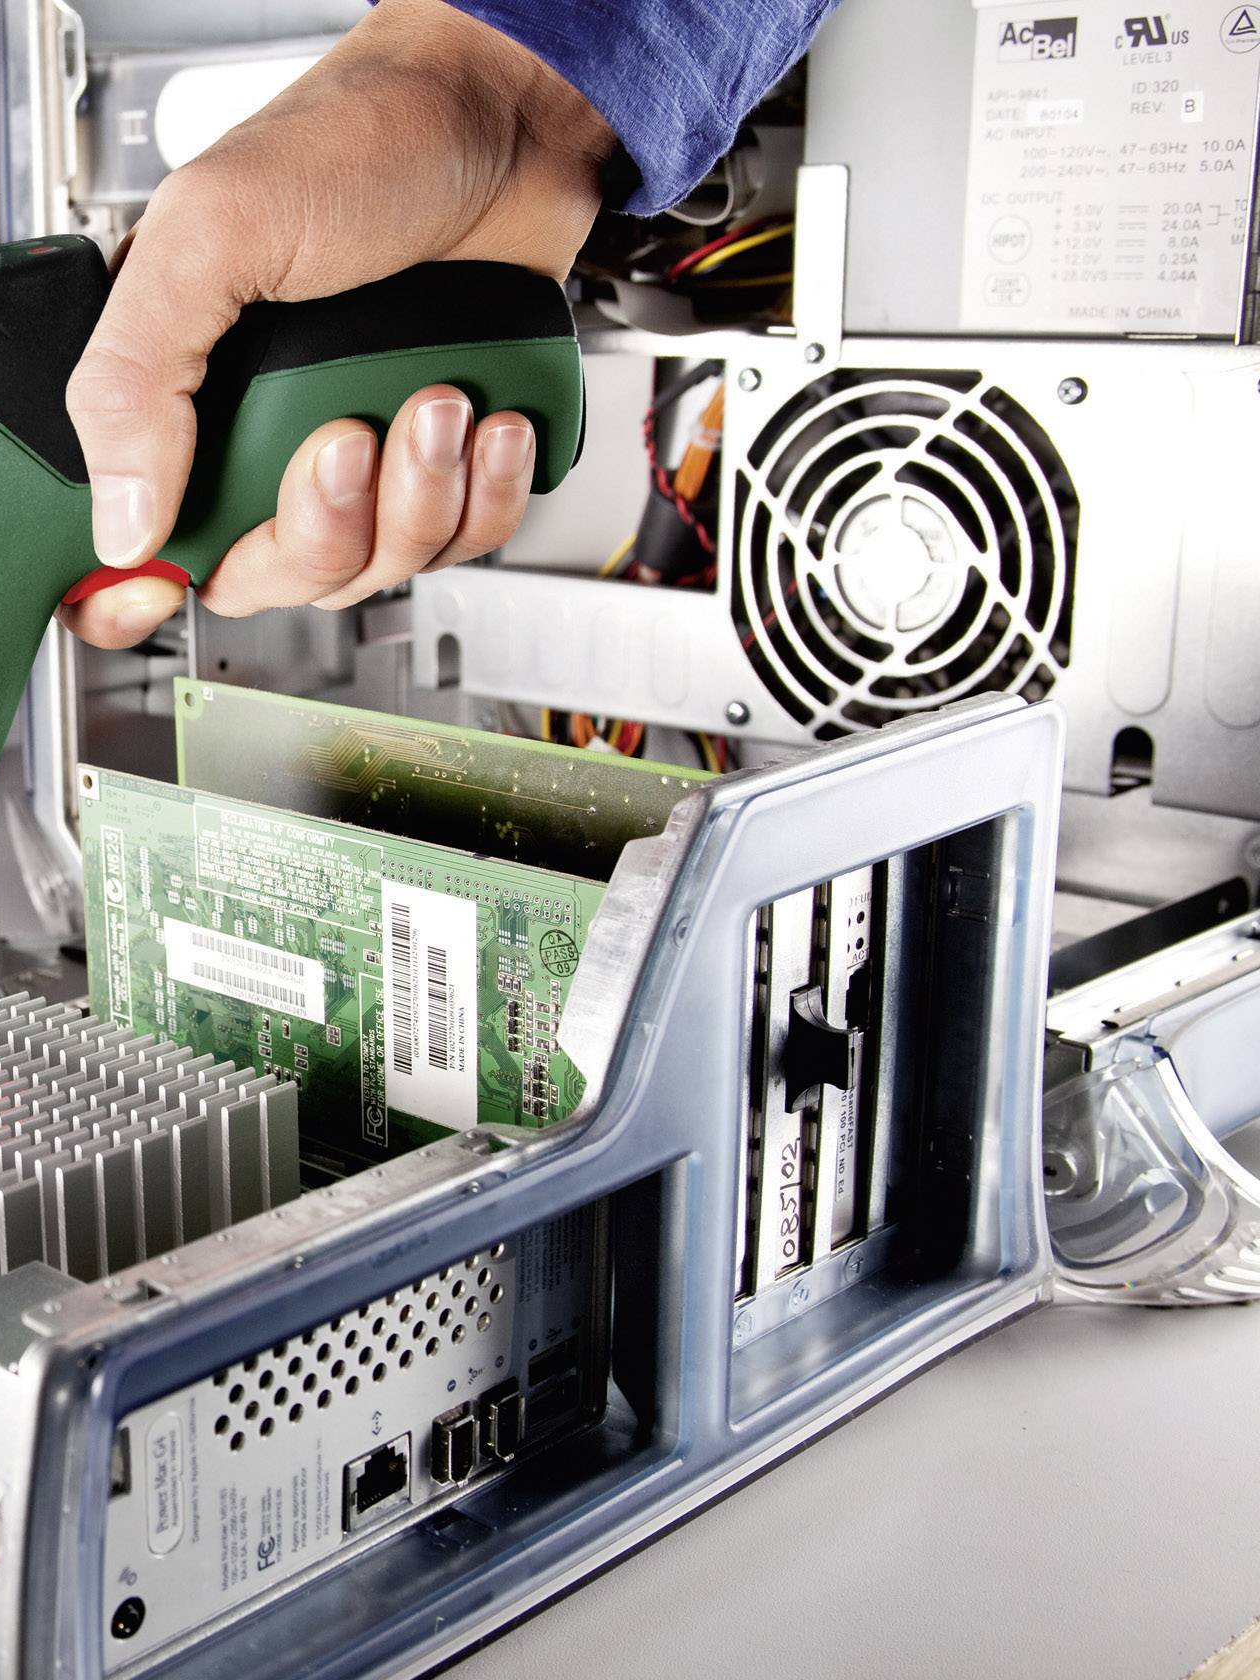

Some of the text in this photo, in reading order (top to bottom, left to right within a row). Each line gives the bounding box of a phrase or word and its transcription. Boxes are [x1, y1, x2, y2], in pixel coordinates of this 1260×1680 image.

[1171, 30, 1189, 45] US
[1123, 52, 1173, 65] LEVEL 3
[1152, 80, 1180, 93] 320
[1184, 100, 1196, 113] B
[1202, 139, 1246, 153] 10.0A
[1200, 160, 1236, 173] 5.0A
[1162, 202, 1203, 215] 20.0A
[1161, 220, 1202, 231] 24.0A
[1168, 236, 1200, 248] 8.0A
[1159, 253, 1199, 266] 0.25A
[1157, 270, 1197, 282] 4.04A
[1068, 306, 1182, 319] MADE IN CHINA
[548, 934, 564, 945] QA
[545, 947, 574, 960] PASS
[557, 962, 570, 974] 09
[458, 1035, 465, 1045] IN
[362, 1034, 370, 1062] COMPLY
[375, 986, 385, 1108] FOR HOME OR OFFICE USE
[458, 1047, 466, 1073] MADE
[363, 1064, 370, 1074] TO
[153, 1461, 167, 1490] Mac
